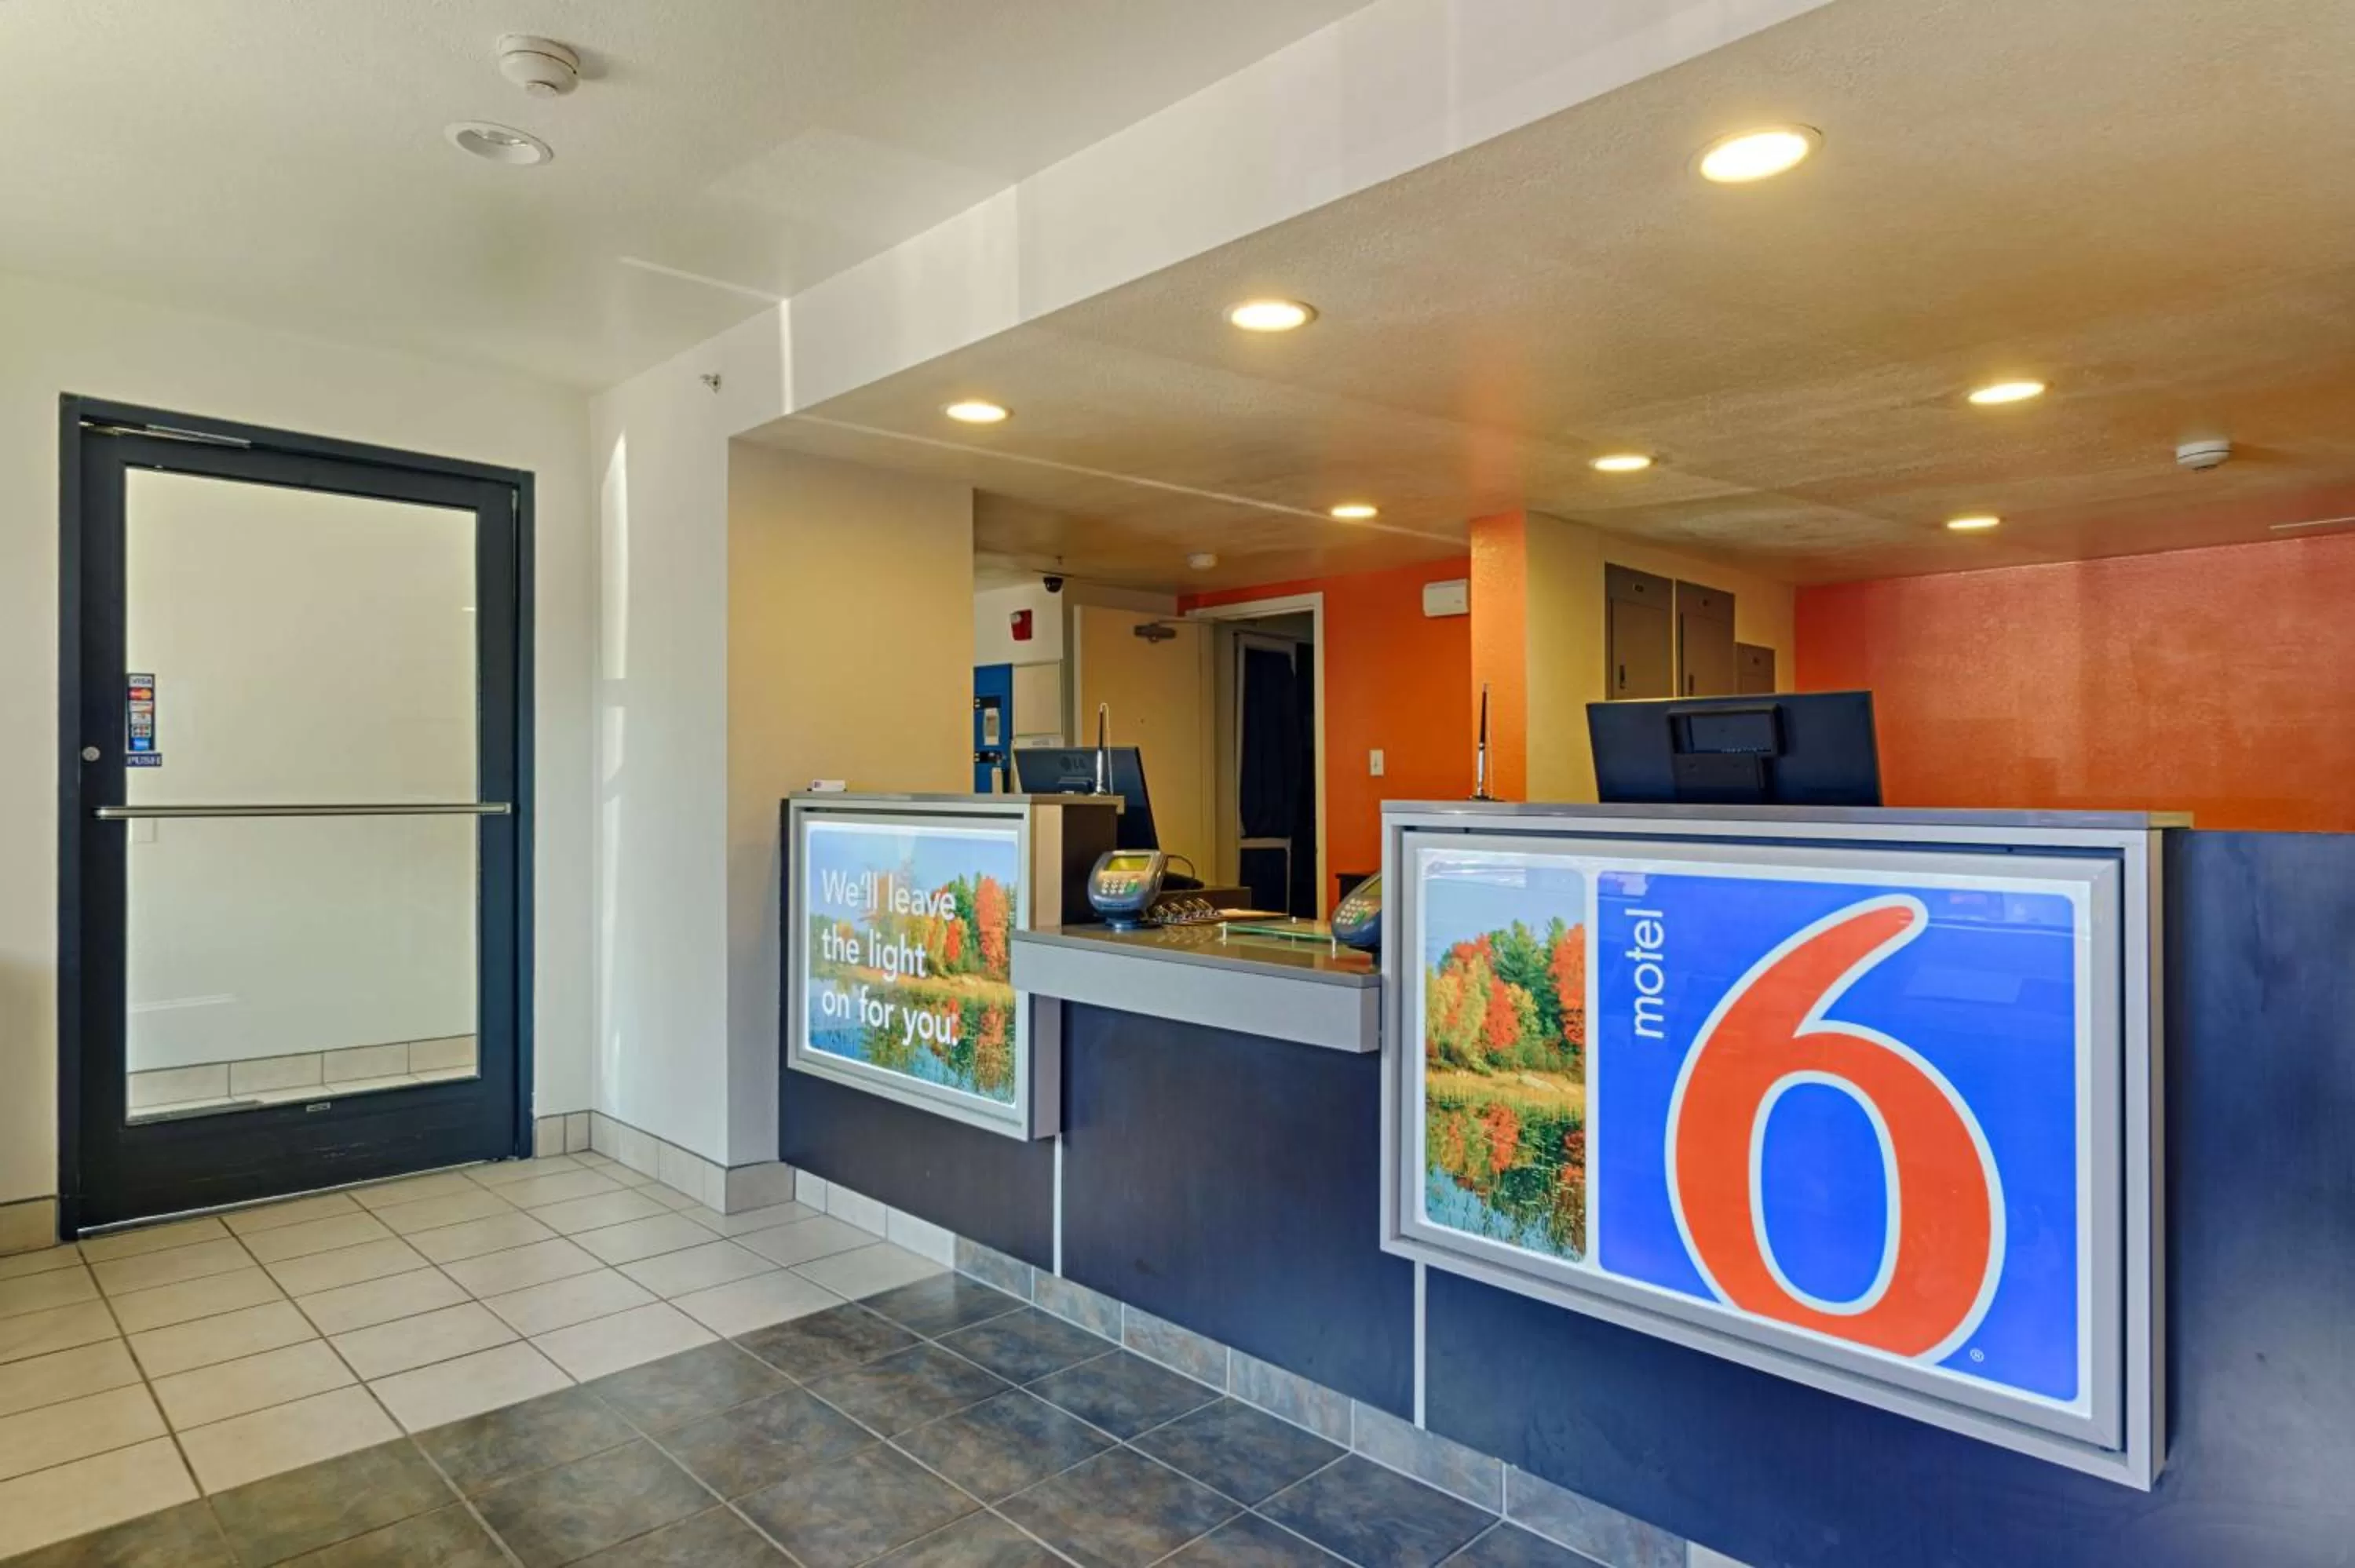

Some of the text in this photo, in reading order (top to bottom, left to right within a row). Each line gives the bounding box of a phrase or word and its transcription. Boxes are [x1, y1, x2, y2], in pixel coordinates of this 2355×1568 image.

[127, 756, 161, 765] PUSH
[822, 869, 956, 921] We'll leave
[822, 923, 927, 982] the light
[822, 985, 958, 1046] on for you.
[1624, 894, 2006, 1366] motel 6
